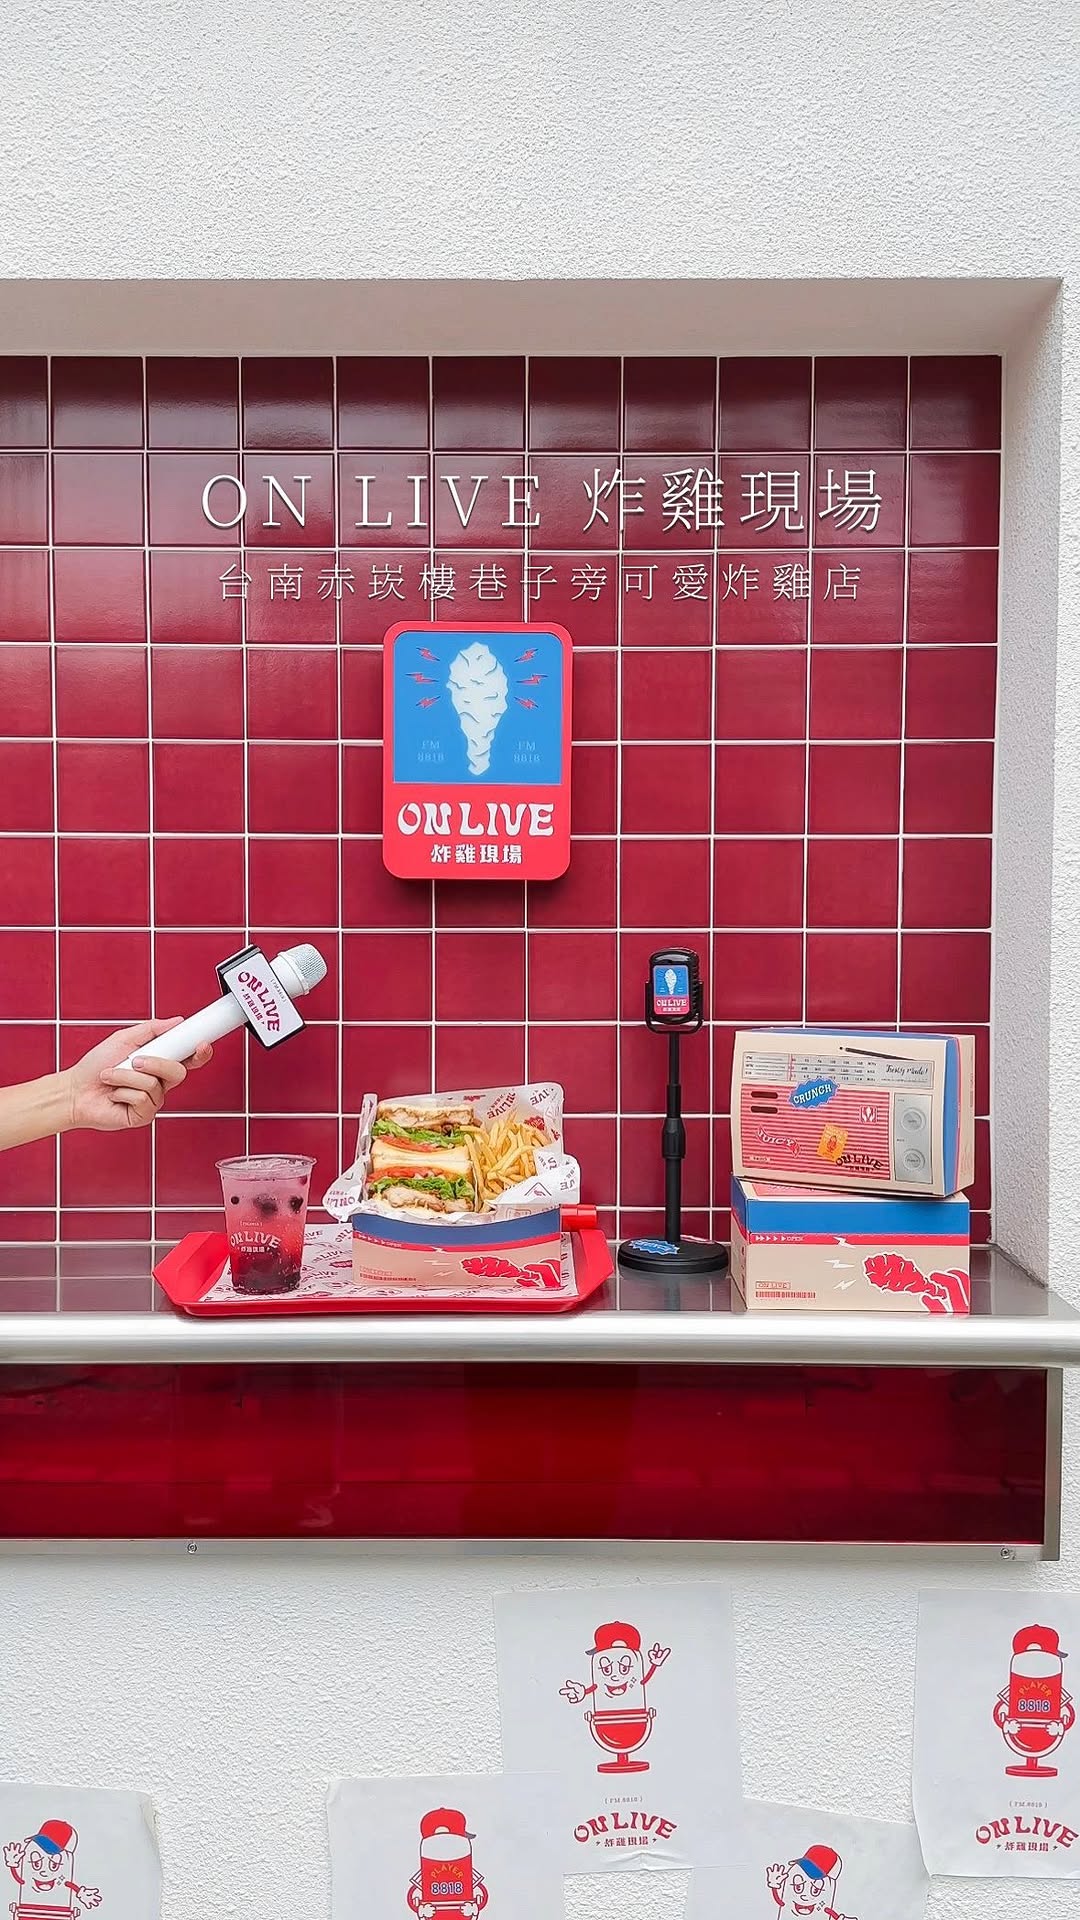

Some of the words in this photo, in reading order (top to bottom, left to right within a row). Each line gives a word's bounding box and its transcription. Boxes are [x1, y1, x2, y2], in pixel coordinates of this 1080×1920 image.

[201, 474, 312, 529] ON
[354, 474, 541, 528] LIVE
[582, 467, 883, 533] 炸雞現場
[218, 563, 862, 601] 台南赤崁樓巷子旁可愛炸雞店
[397, 802, 452, 836] ON
[458, 802, 554, 837] LIVE
[430, 843, 523, 864] 炸雞現場
[237, 970, 263, 993] ON
[257, 987, 281, 1032] LIVE
[793, 1083, 832, 1104] CRUNCH
[757, 1130, 795, 1147] JUICY
[230, 1232, 244, 1247] ON
[243, 1230, 282, 1249] LIVE
[1018, 1681, 1052, 1698] PLAYER
[1017, 1699, 1051, 1712] 8818
[573, 1815, 609, 1843] ON
[611, 1811, 678, 1840] LIVE
[975, 1817, 1011, 1845] ON
[1013, 1815, 1080, 1848] LIVE
[430, 1863, 464, 1879] PLAYER
[431, 1881, 463, 1895] 8818
